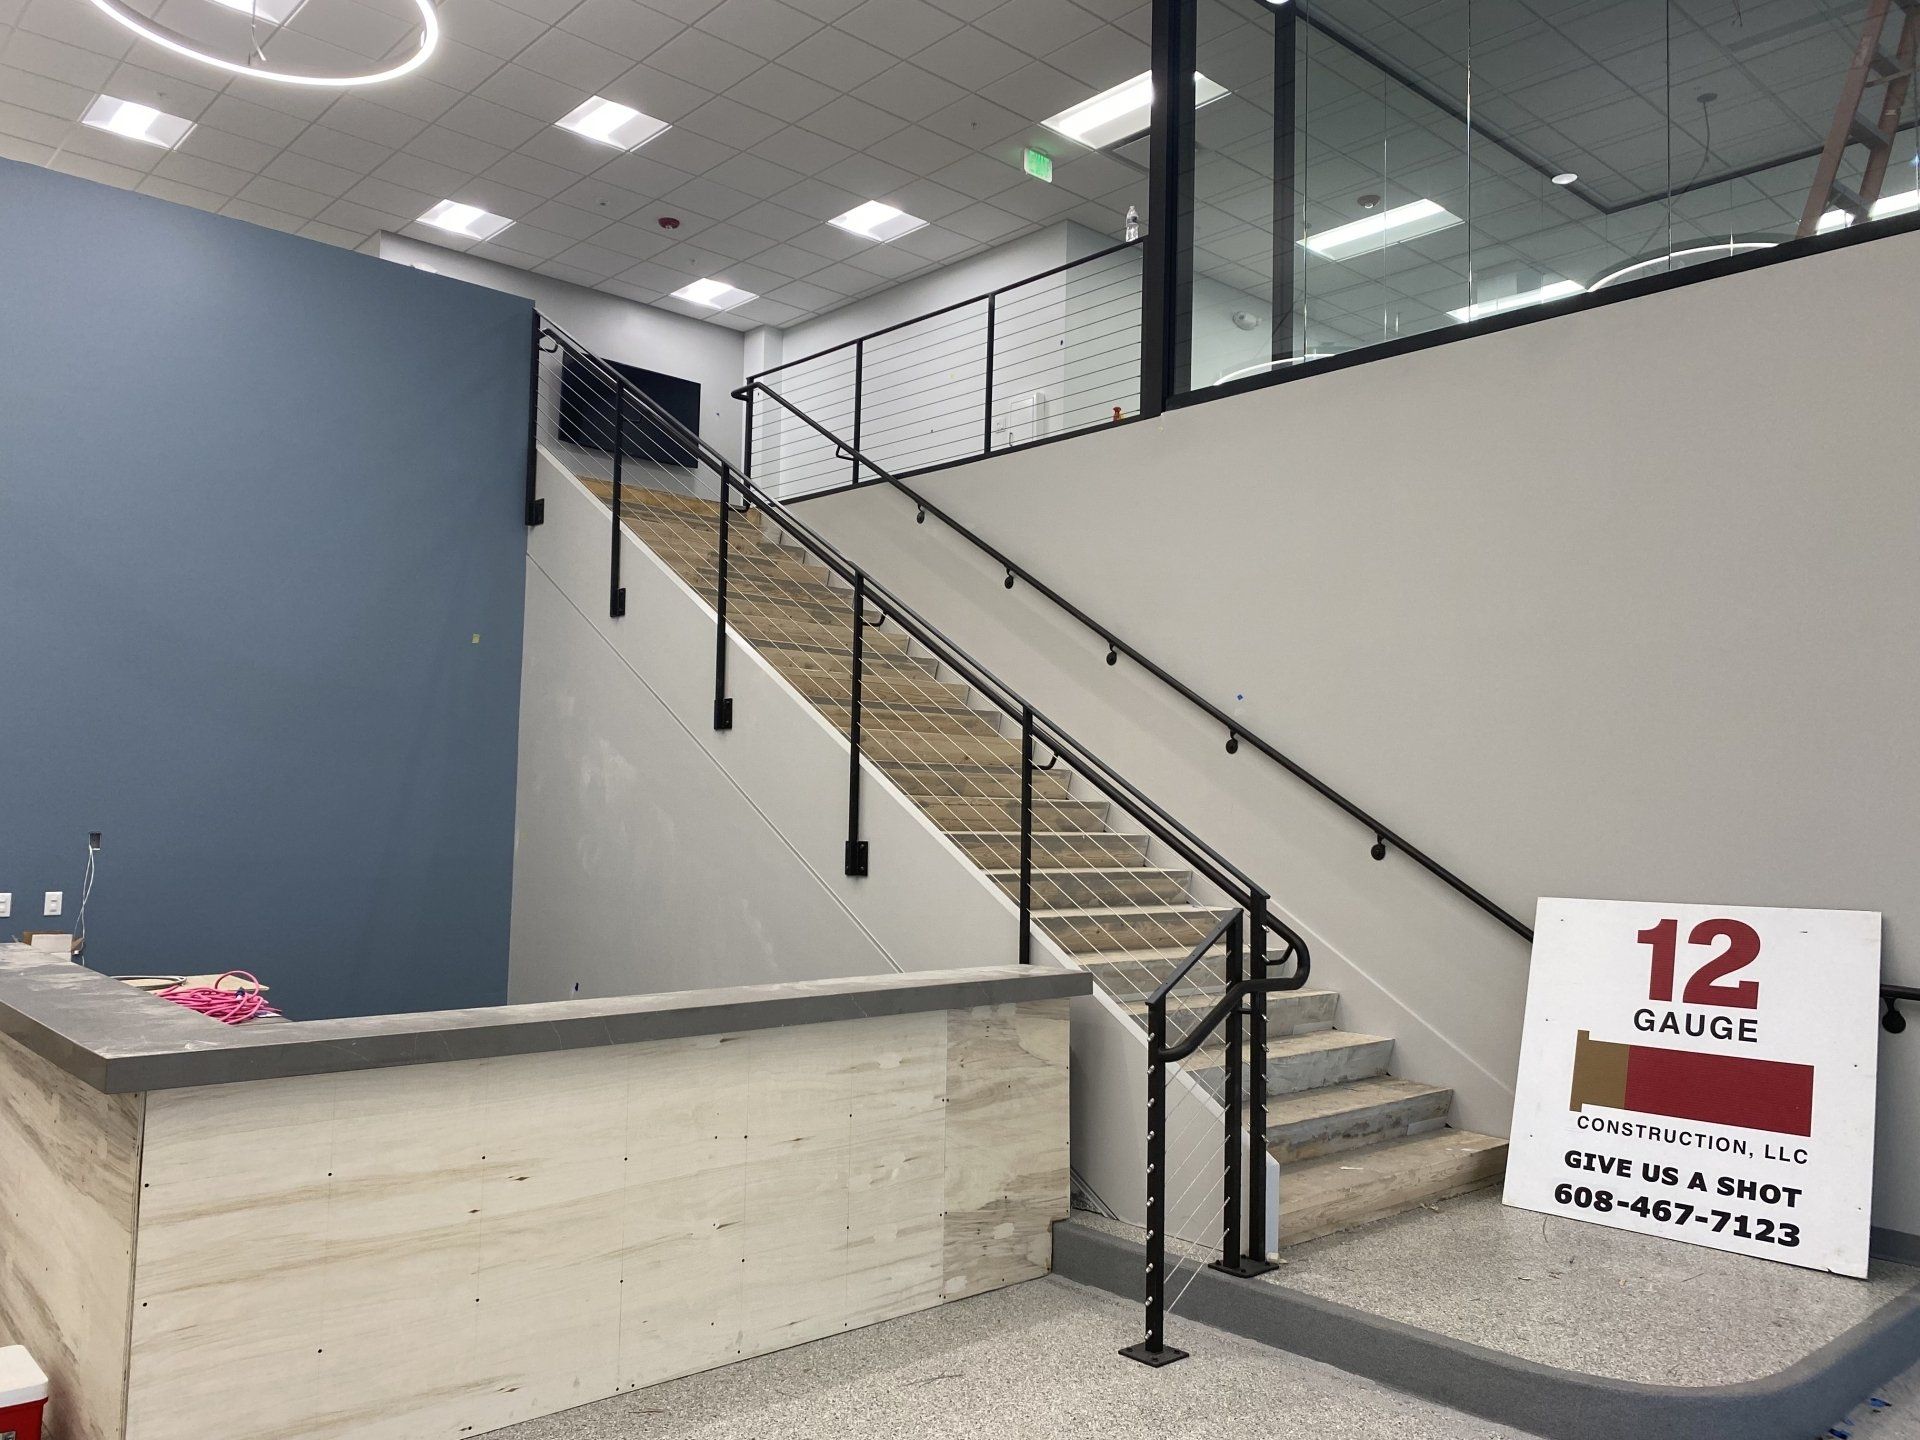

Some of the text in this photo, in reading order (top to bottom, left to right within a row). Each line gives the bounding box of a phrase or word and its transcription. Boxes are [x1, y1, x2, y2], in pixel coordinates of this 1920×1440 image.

[1637, 918, 1761, 1010] 12
[1633, 1008, 1758, 1043] GAUGE
[1577, 1115, 1809, 1165] CONSTRUCTION, LLC
[1564, 1149, 1803, 1208] GIVE US A SHOT
[1554, 1183, 1801, 1248] 608-467-7123
